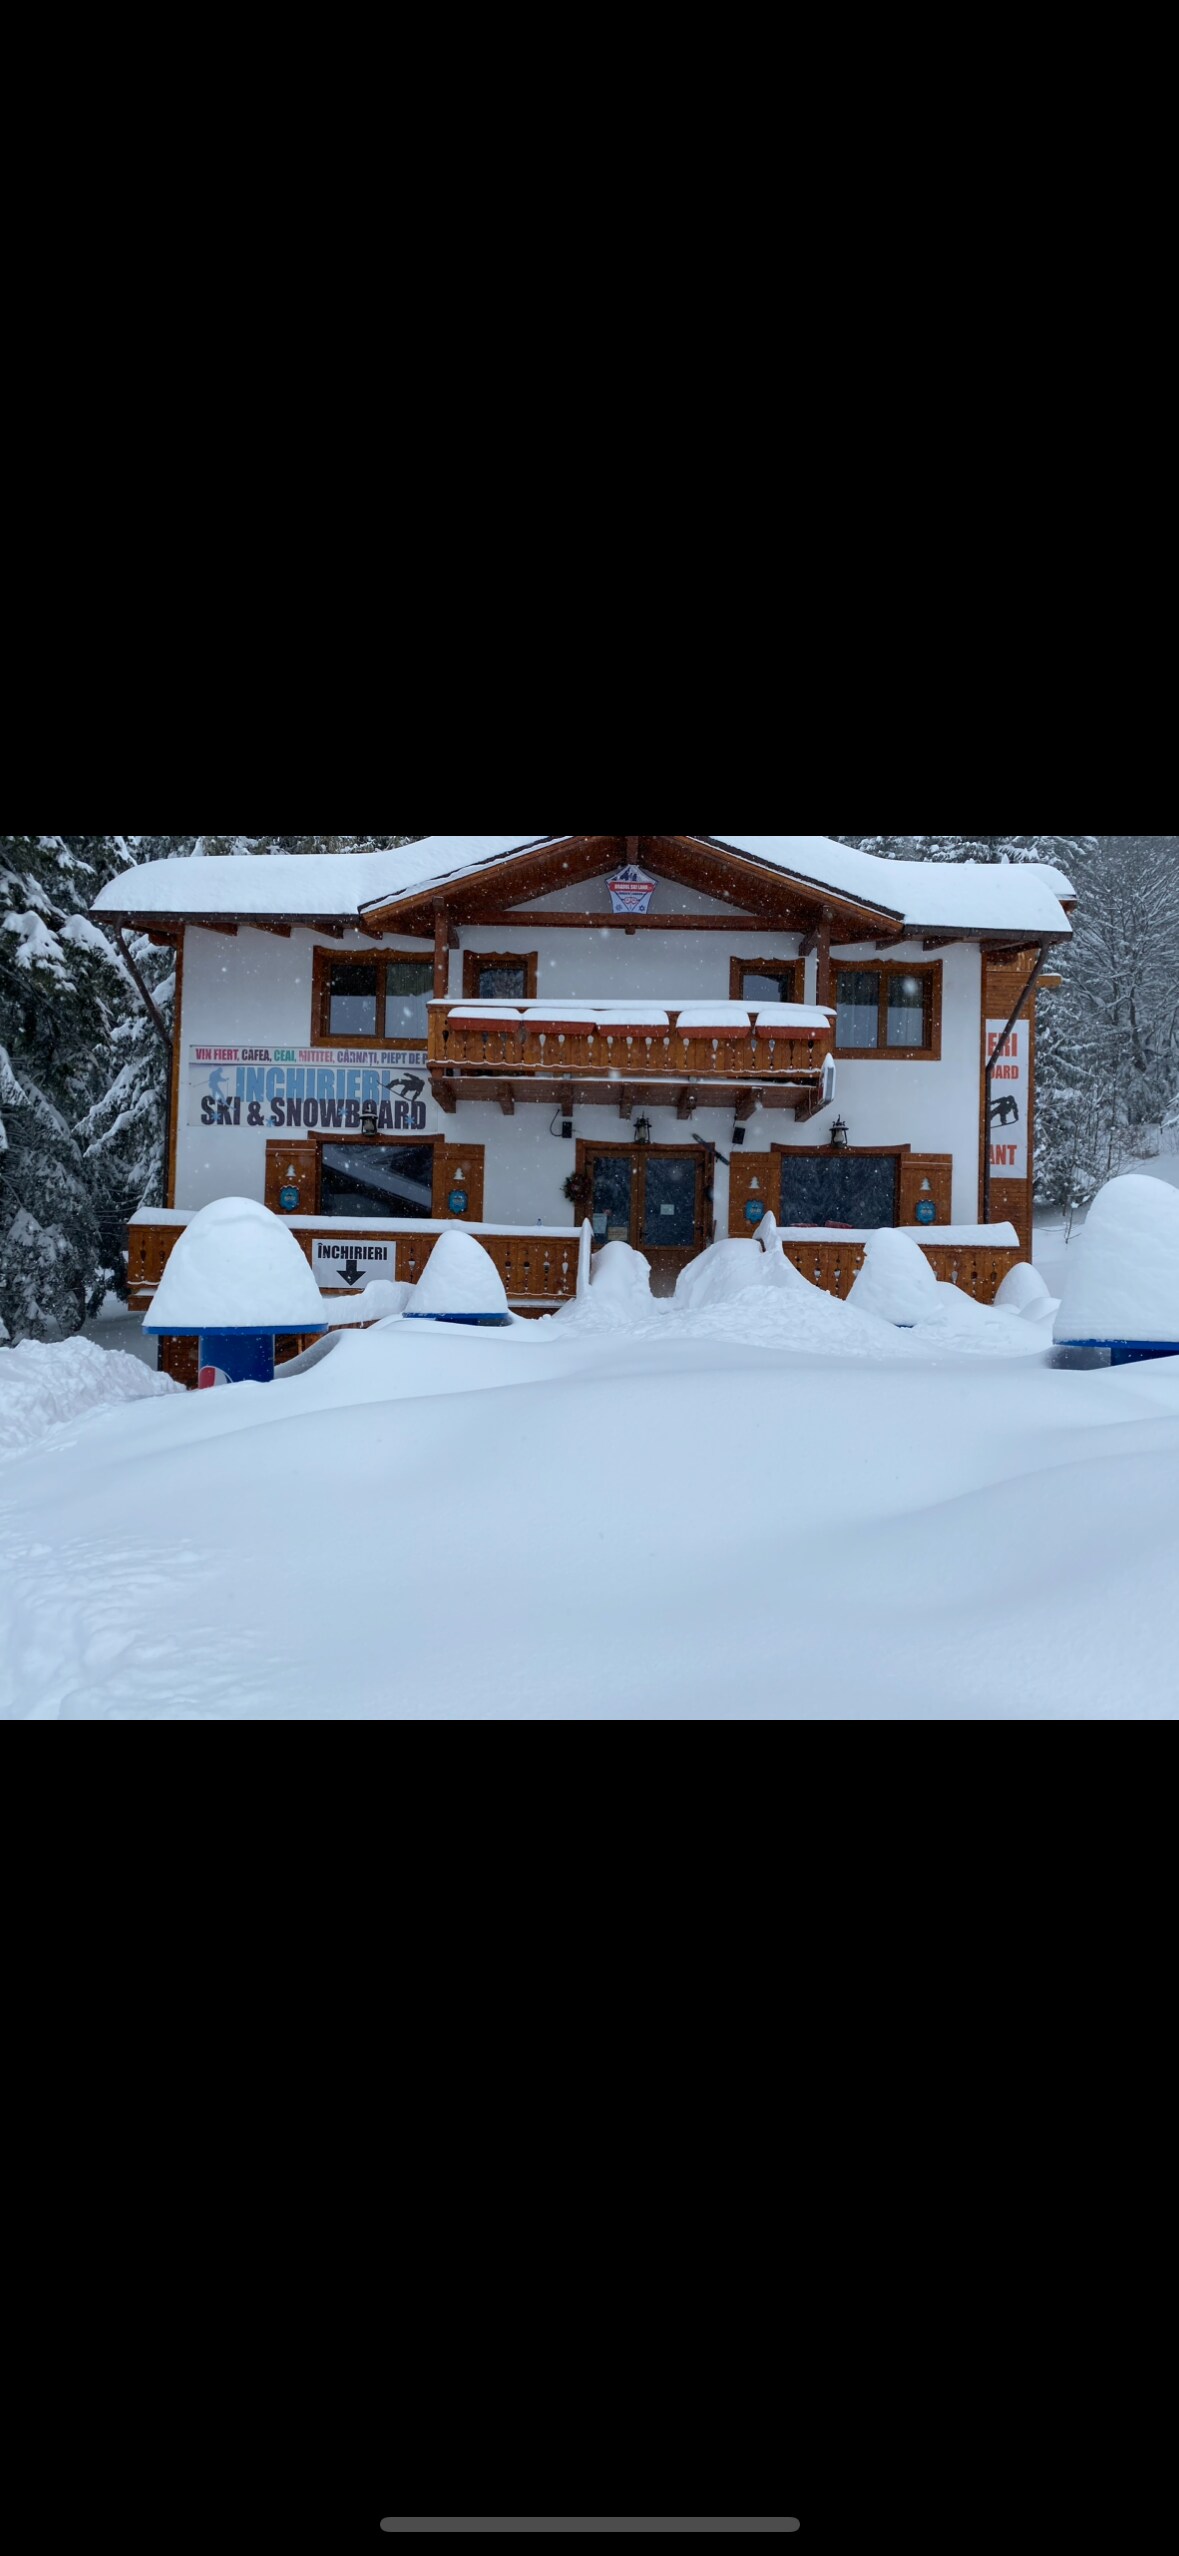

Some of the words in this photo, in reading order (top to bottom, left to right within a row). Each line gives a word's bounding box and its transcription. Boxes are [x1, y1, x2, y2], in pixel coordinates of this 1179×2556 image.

[195, 1048, 212, 1060] VIN
[213, 1048, 240, 1061] FIERT,
[241, 1049, 272, 1062] CAFEA,
[273, 1050, 297, 1062] CEAI,
[381, 1052, 407, 1064] PIEPT
[408, 1053, 421, 1064] DE
[991, 1065, 1019, 1080] ARD
[235, 1067, 391, 1105] INCHIRIERI
[200, 1095, 241, 1126] SKI
[246, 1101, 265, 1126] &
[317, 1242, 388, 1261] ÎNCHIRIERI
